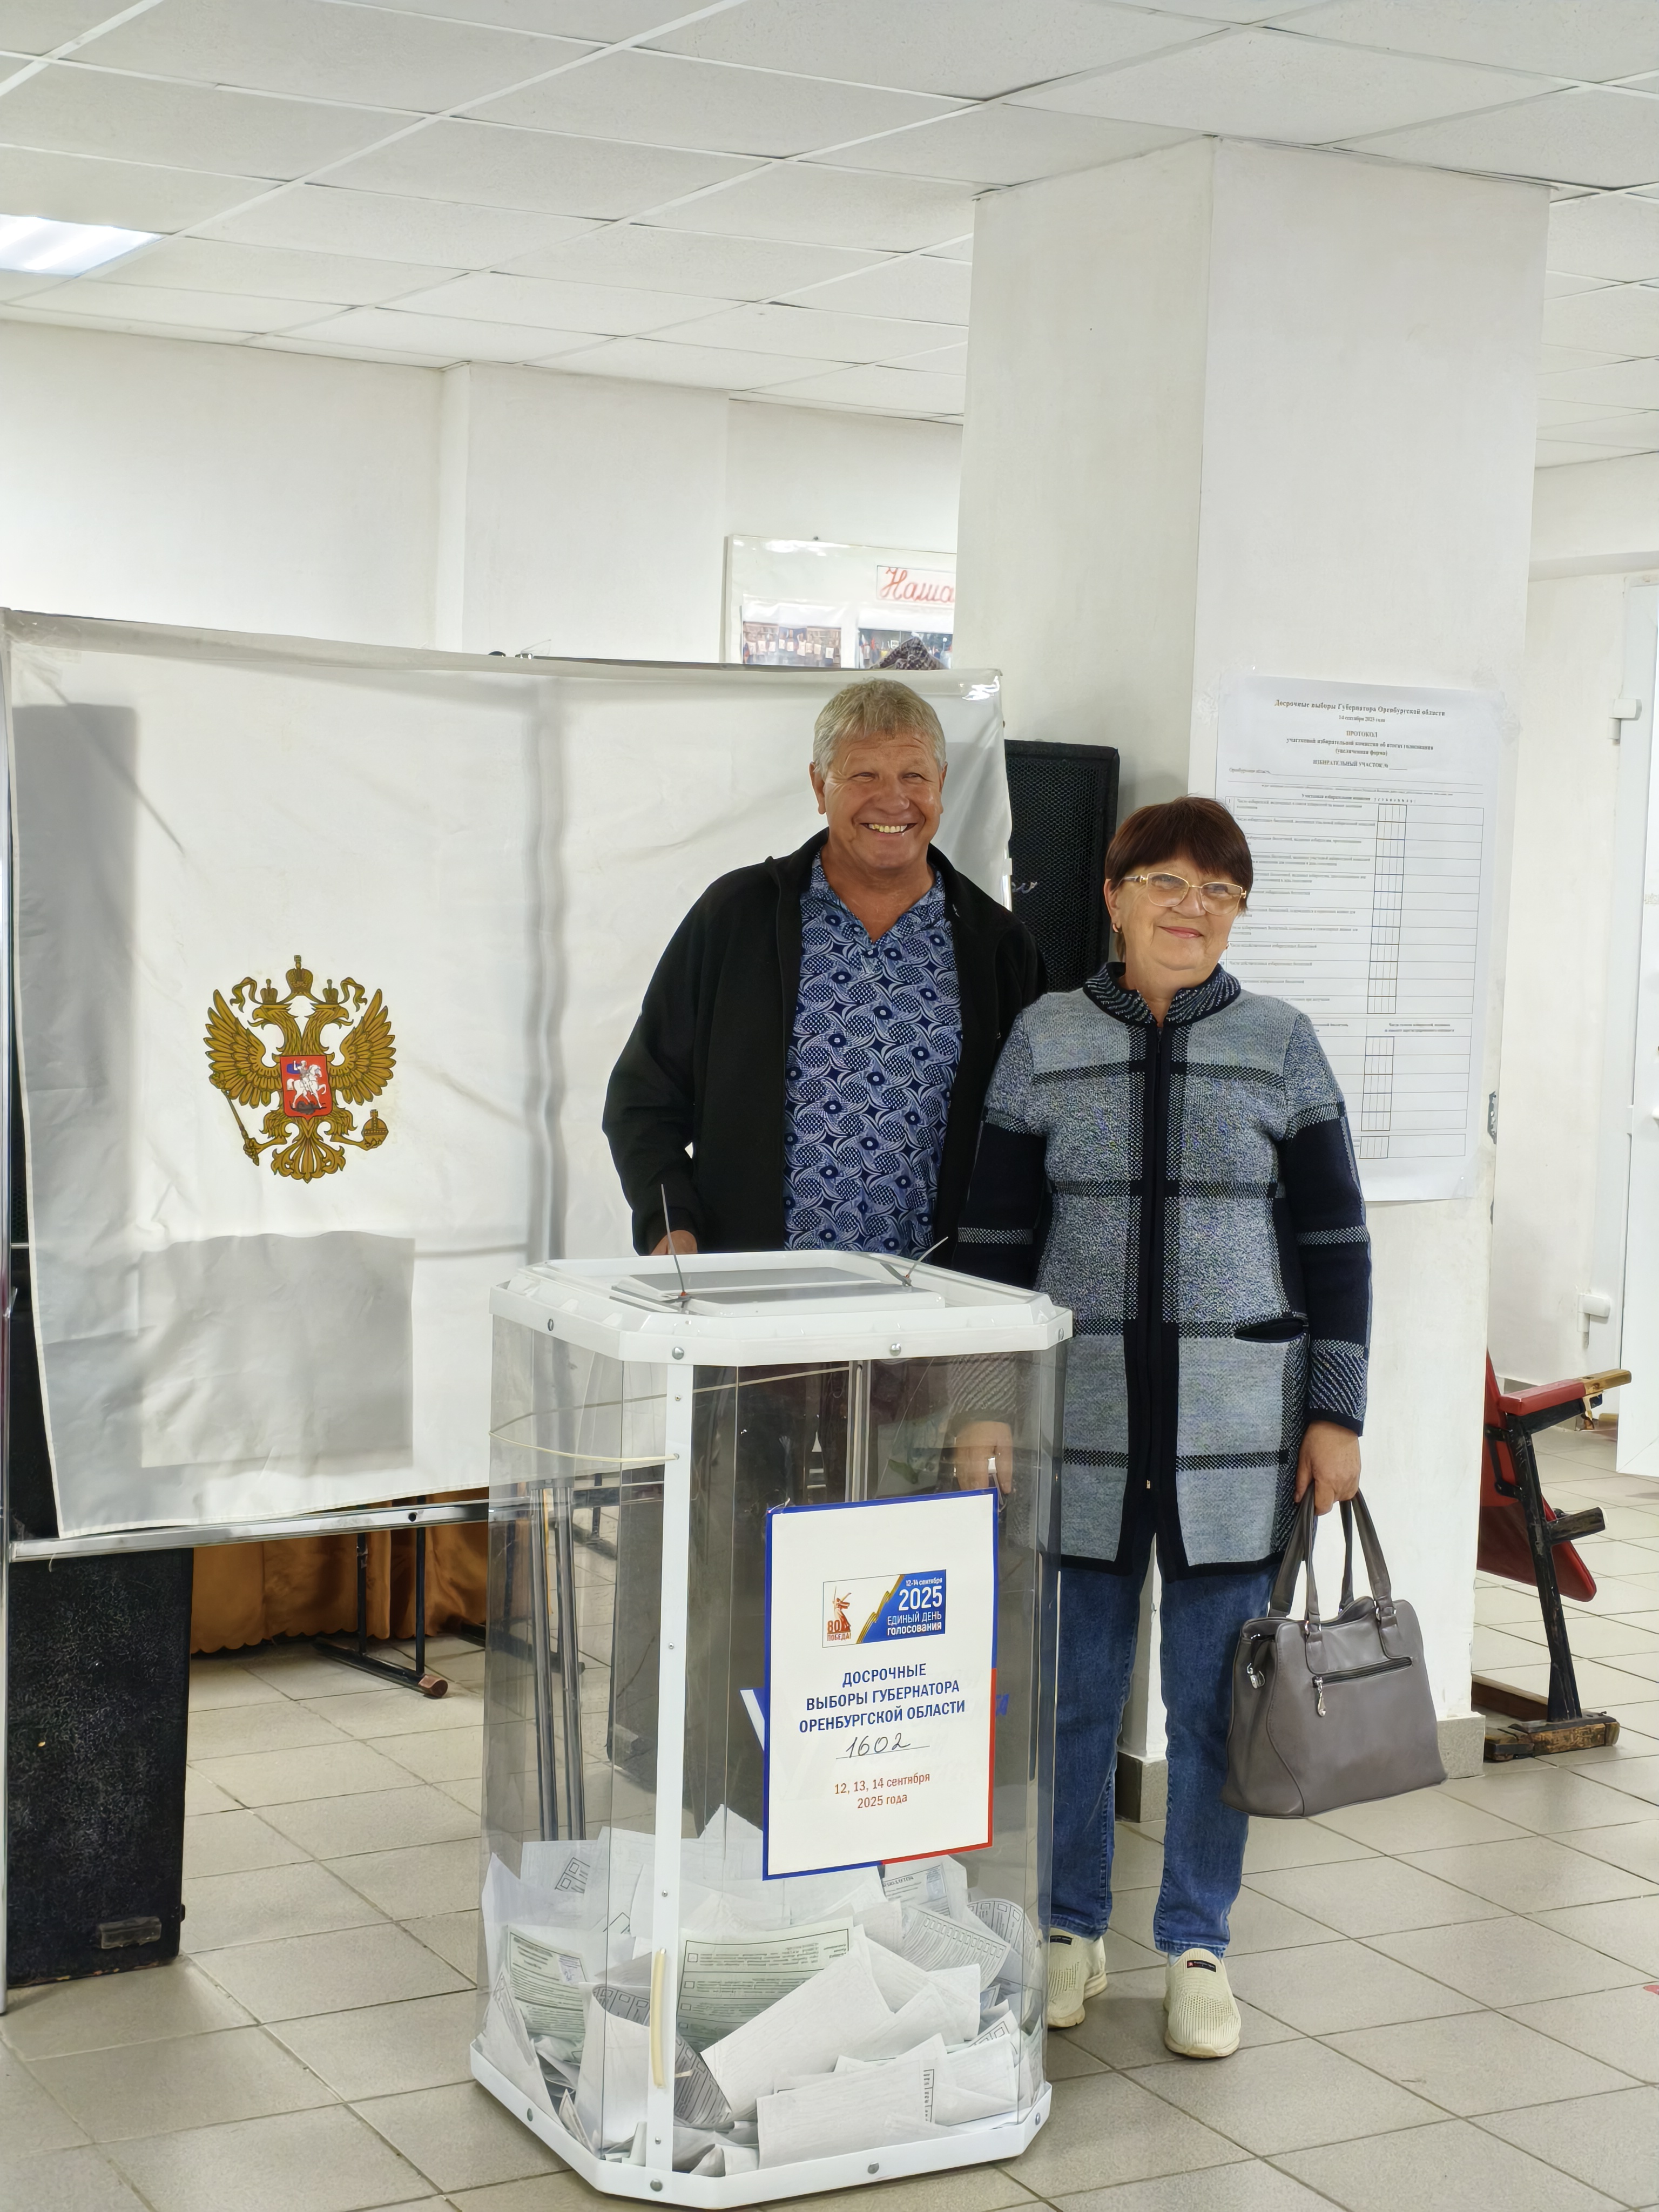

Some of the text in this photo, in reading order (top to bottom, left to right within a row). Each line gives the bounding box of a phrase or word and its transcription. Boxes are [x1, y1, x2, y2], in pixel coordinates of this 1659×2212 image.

[880, 567, 955, 603] Наша
[1274, 699, 1445, 717] Досрочные выборы Губернатора Оренбургской области
[919, 1577, 942, 1586] сентября
[898, 1585, 942, 1611] 2025
[887, 1610, 942, 1626] ЕДИНЫЙ ДЕНЬ
[842, 1663, 926, 1688] ДОСРОЧНЫЕ
[806, 1680, 960, 1711] ВЫБОРЫ ГУБЕРНАТОРА
[799, 1700, 965, 1733] ОРЕНБУРГСКОЙ ОБЛАСТИ
[845, 1732, 911, 1758] 1602
[834, 1772, 930, 1795] 12, 13, 14 сентября
[857, 1793, 907, 1809] 2025 года
